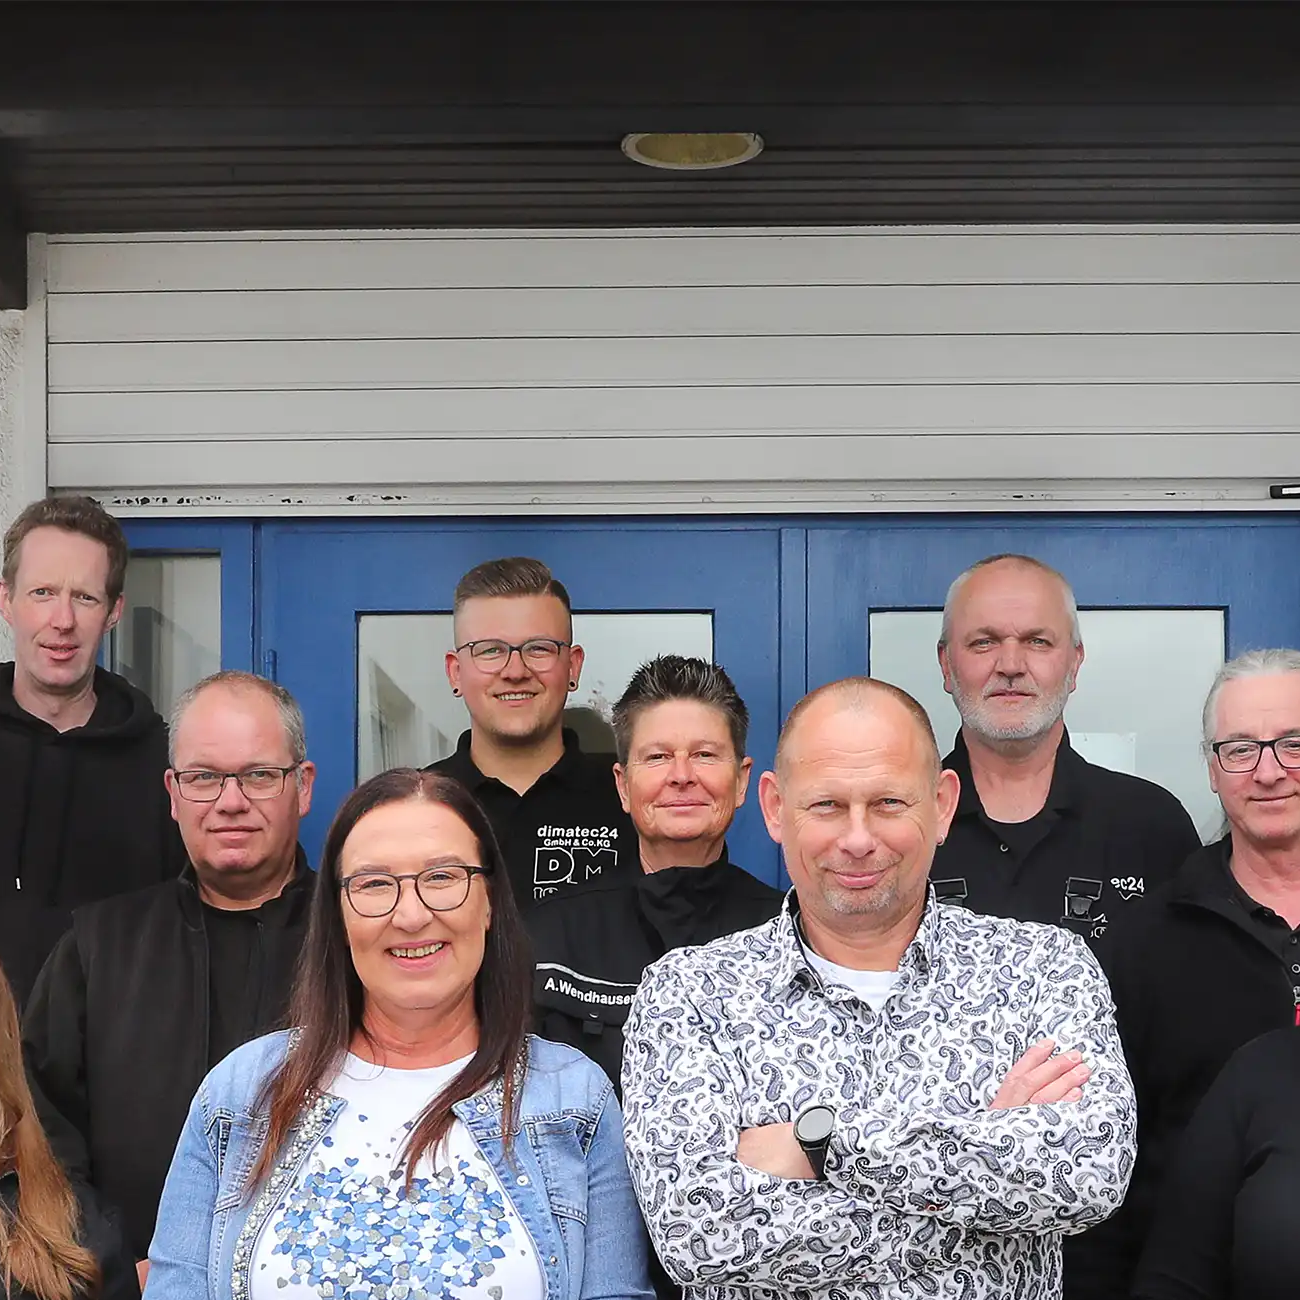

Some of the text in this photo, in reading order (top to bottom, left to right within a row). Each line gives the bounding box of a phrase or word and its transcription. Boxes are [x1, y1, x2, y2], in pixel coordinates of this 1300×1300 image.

[537, 824, 619, 840] dimatec24
[543, 838, 572, 847] GmbH
[573, 838, 580, 846] &
